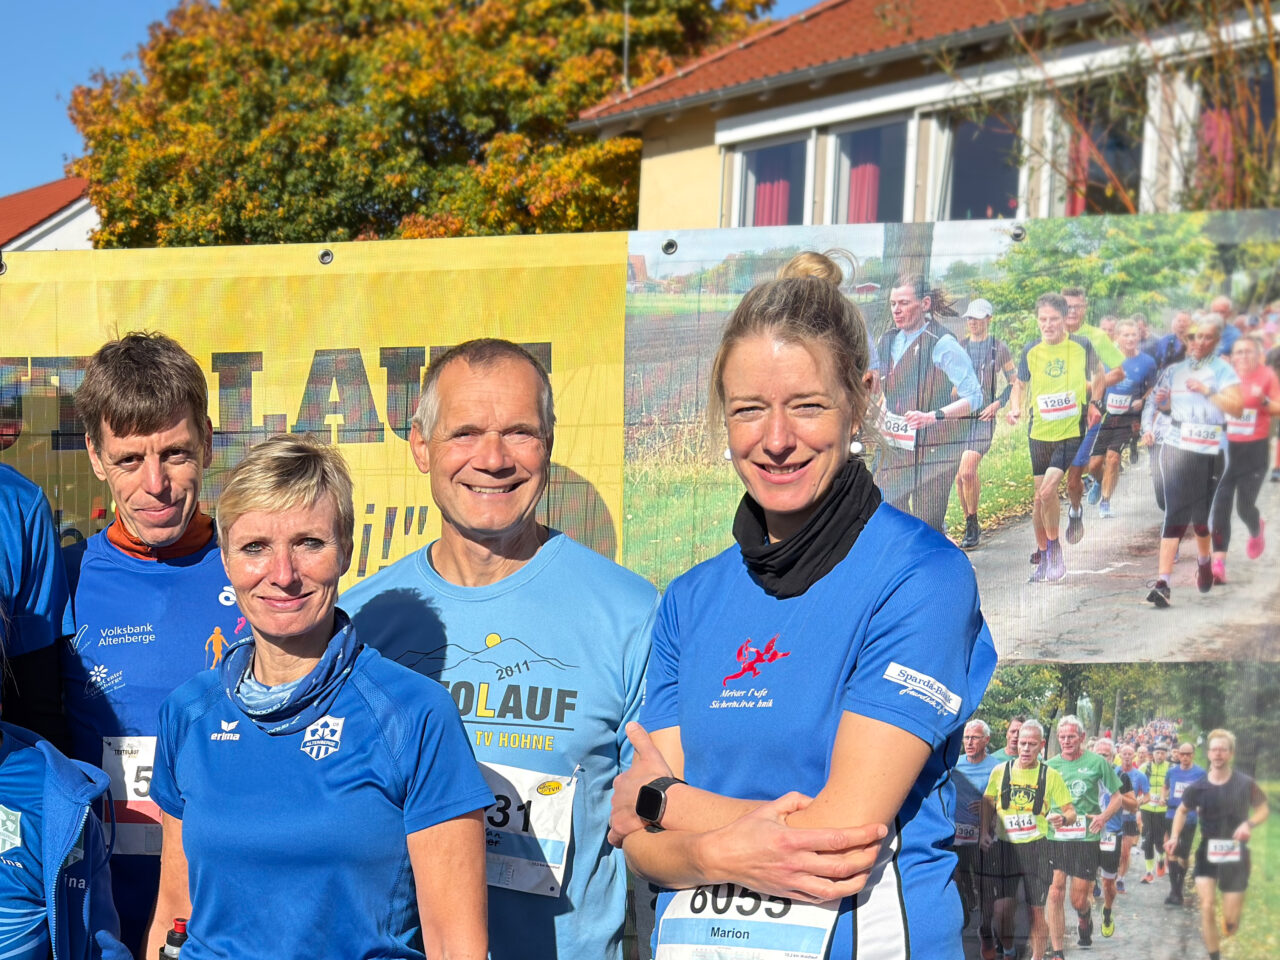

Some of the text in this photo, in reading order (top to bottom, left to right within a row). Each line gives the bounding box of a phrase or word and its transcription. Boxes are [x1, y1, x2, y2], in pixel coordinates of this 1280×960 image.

[1044, 397, 1071, 408] 1286
[885, 420, 909, 433] 084
[100, 623, 153, 637] Volksbank
[98, 633, 156, 647] Altenberge
[496, 660, 530, 681] 2011
[440, 681, 578, 723] OLAUF
[210, 732, 240, 741] erima
[475, 730, 554, 751] TV HOHNE
[487, 795, 532, 832] 31
[1009, 819, 1033, 828] 1414
[710, 926, 750, 939] Marion
